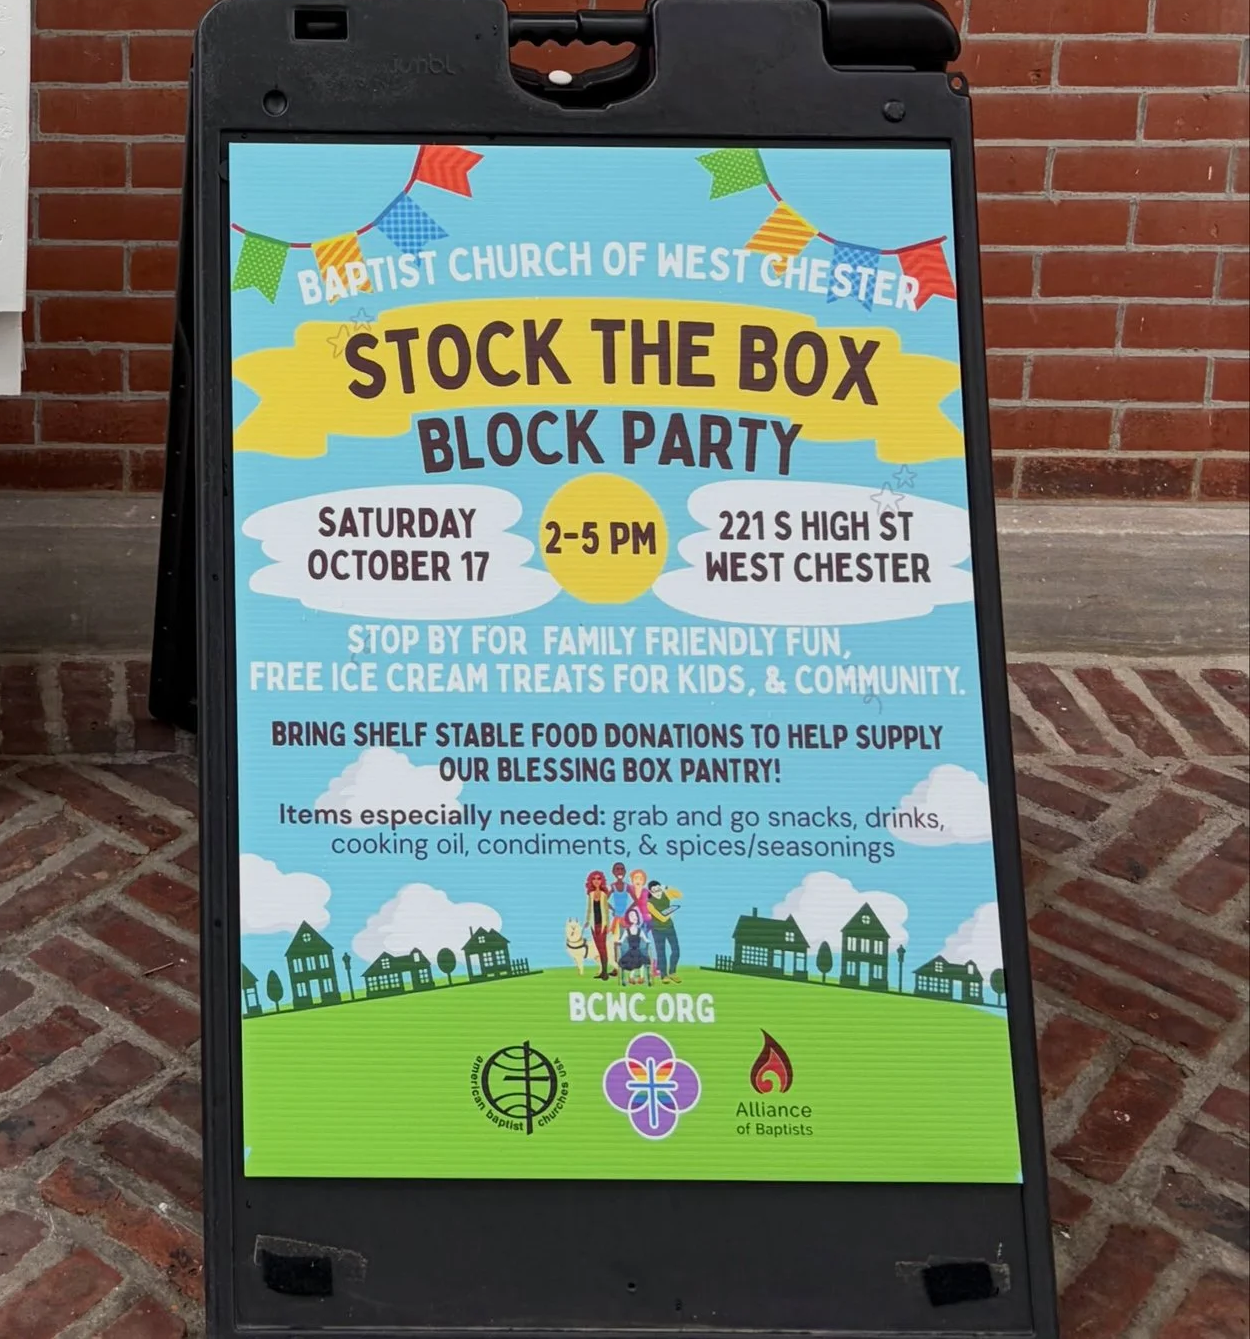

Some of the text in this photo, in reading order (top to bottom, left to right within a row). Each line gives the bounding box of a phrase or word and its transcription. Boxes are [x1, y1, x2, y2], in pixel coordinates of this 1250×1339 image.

[298, 241, 920, 312] BAPTIST CHURCH OF WEST CHESTER
[344, 317, 880, 407] STOCK THE BOX
[417, 409, 804, 476] BLOCK PARTY
[318, 506, 477, 539] SATURDAY
[544, 519, 658, 556] 2-5 PM
[718, 510, 914, 542] 221 S HIGH ST
[307, 551, 490, 583] OCTOBER 17
[705, 552, 932, 585] WEST CHESTER
[347, 624, 852, 659] STOP BY FOR FAMILY FRIENDLY FUN,
[249, 663, 967, 697] FREE ICE CREAM TREATS FOR KIDS, & COMMUNITY.
[270, 721, 943, 752] BRING SHELF STABLE FOOD DONATIONS TO HELP SUPPLY
[438, 757, 782, 785] OUR BLESSING BOX PANTRY!
[278, 802, 946, 834] Items especially needed: grab and go snacks, drinks,
[330, 834, 895, 865] cooking oil, condiments, & spices/seasonings
[568, 991, 715, 1023] BCWC.ORG
[471, 1056, 486, 1110] american
[486, 1109, 523, 1131] baptist
[537, 1082, 569, 1127] churches
[736, 1101, 812, 1118] Alliance
[737, 1123, 813, 1137] of Baptists
